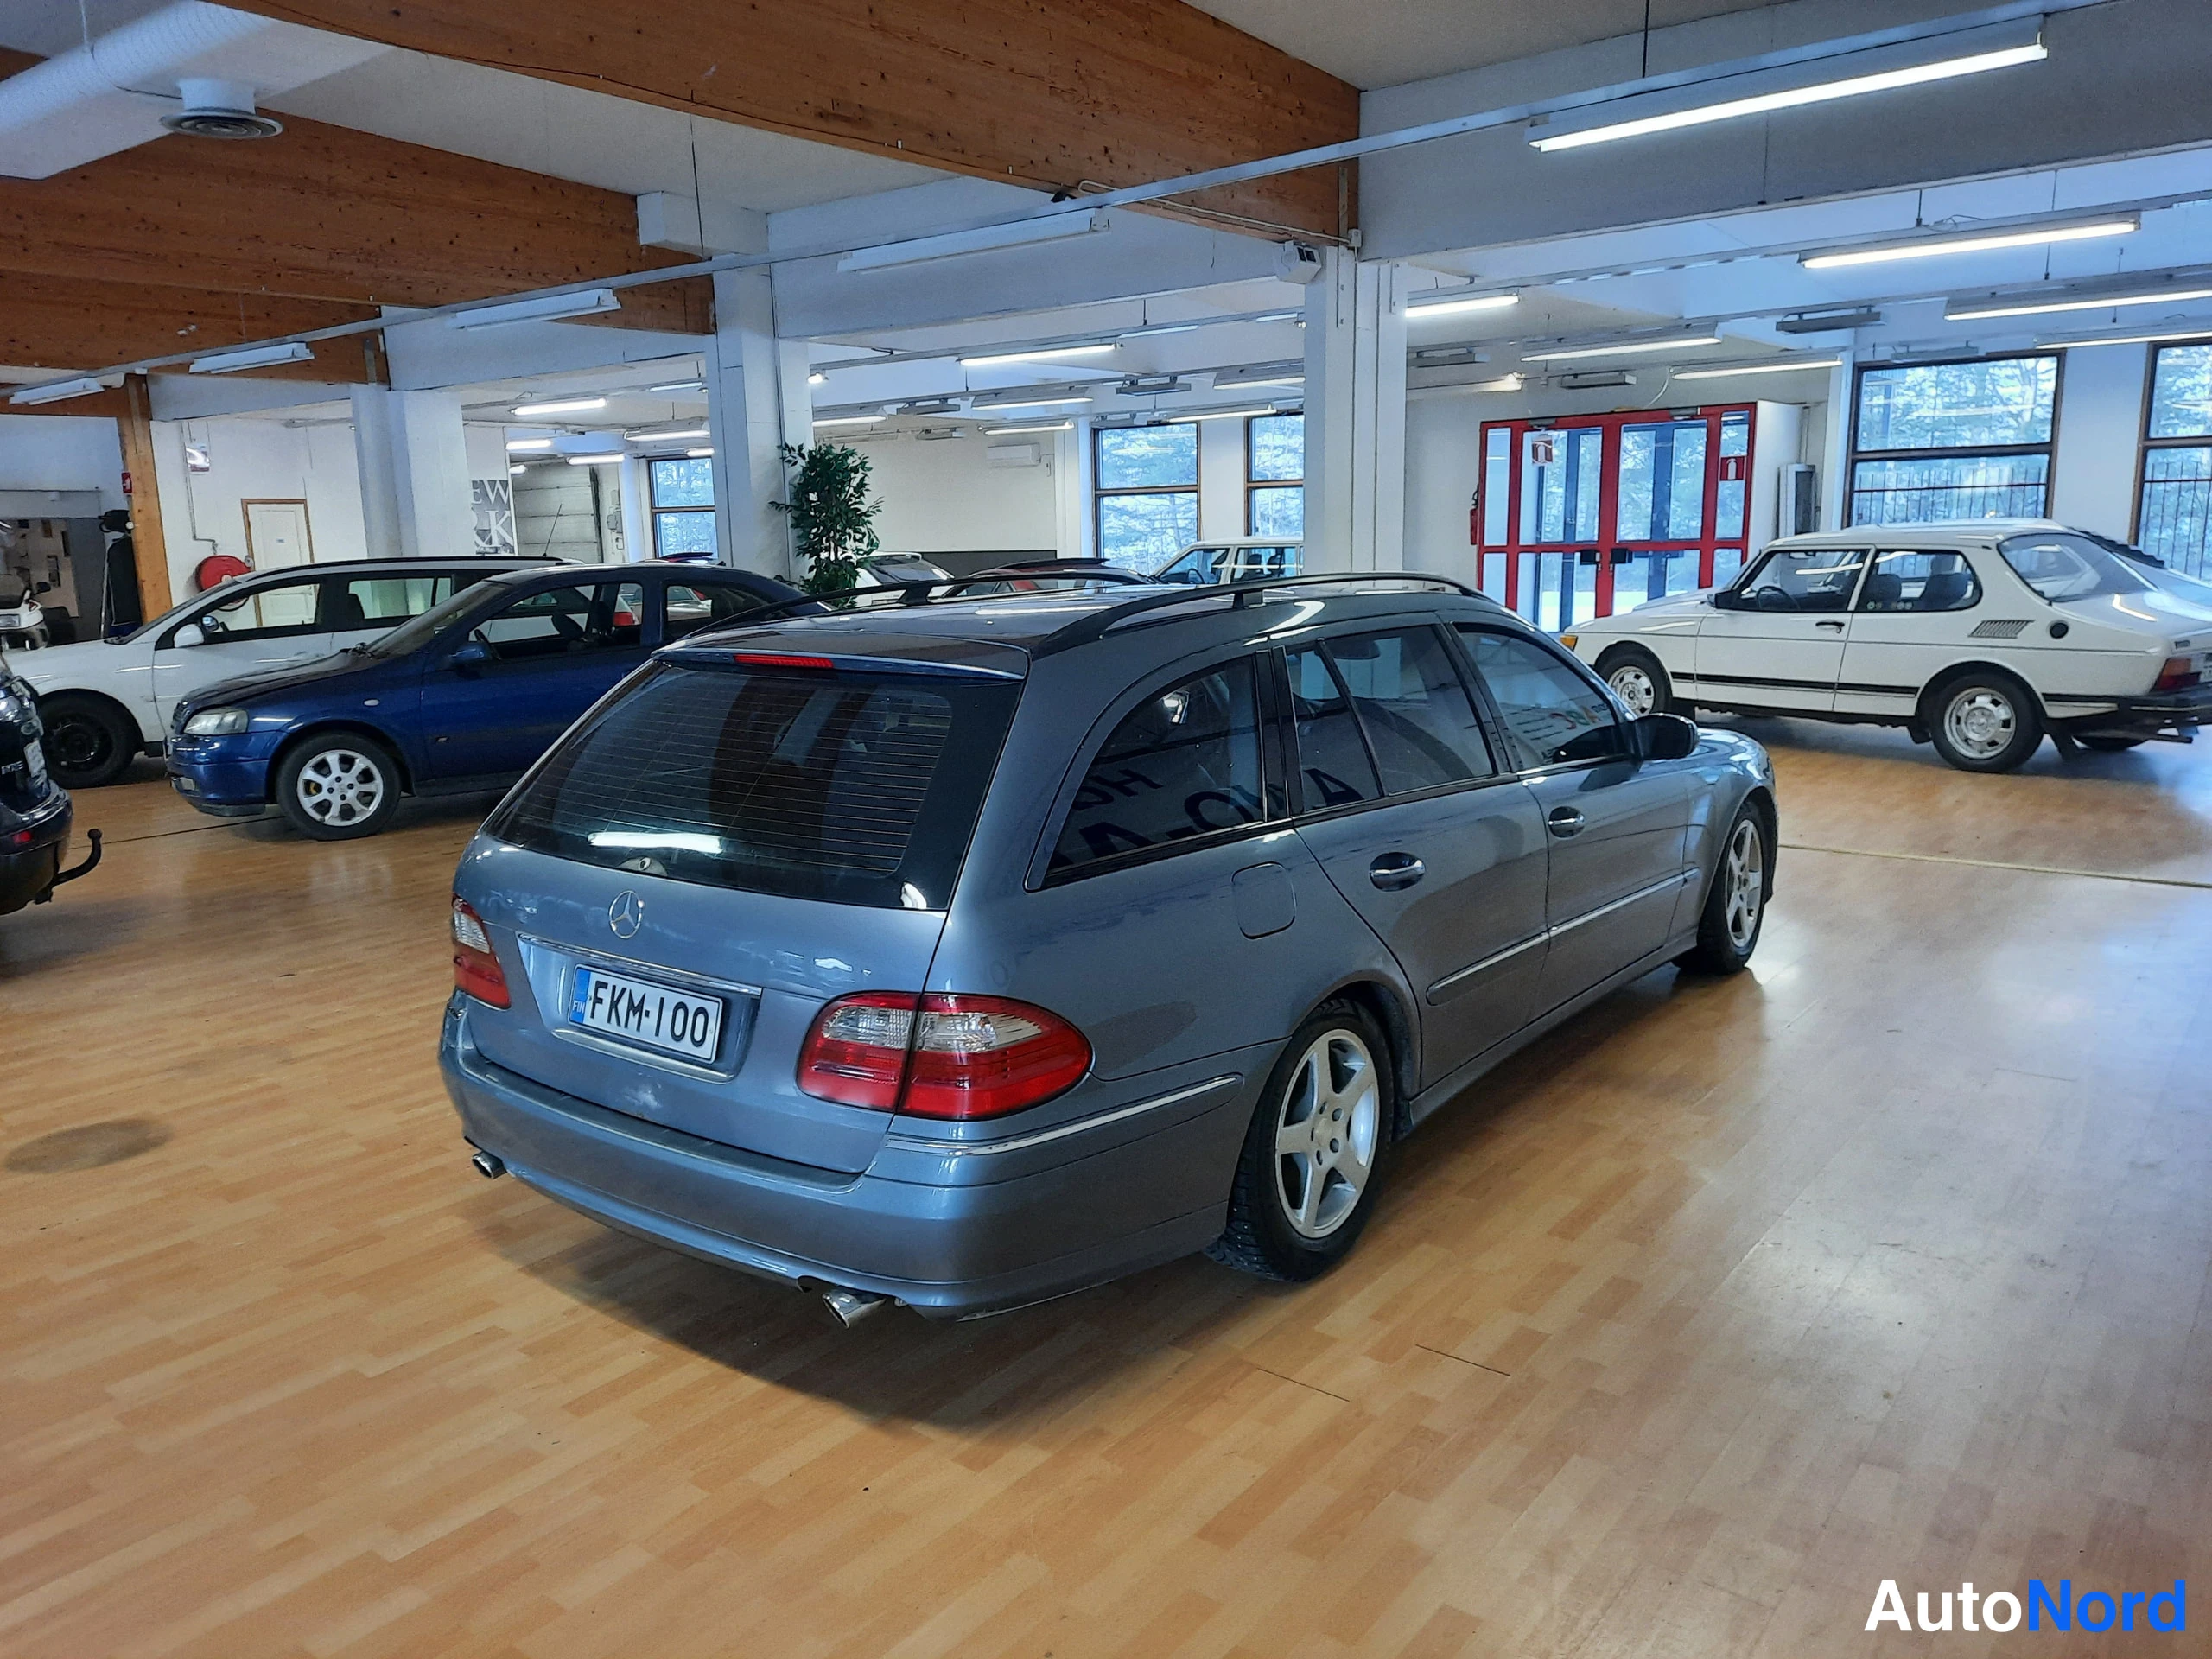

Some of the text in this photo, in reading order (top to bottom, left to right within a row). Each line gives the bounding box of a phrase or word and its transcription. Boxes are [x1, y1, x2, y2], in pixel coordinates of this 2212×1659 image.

[471, 480, 509, 505] EW
[572, 1001, 586, 1014] FIN
[589, 980, 709, 1047] FKM-100
